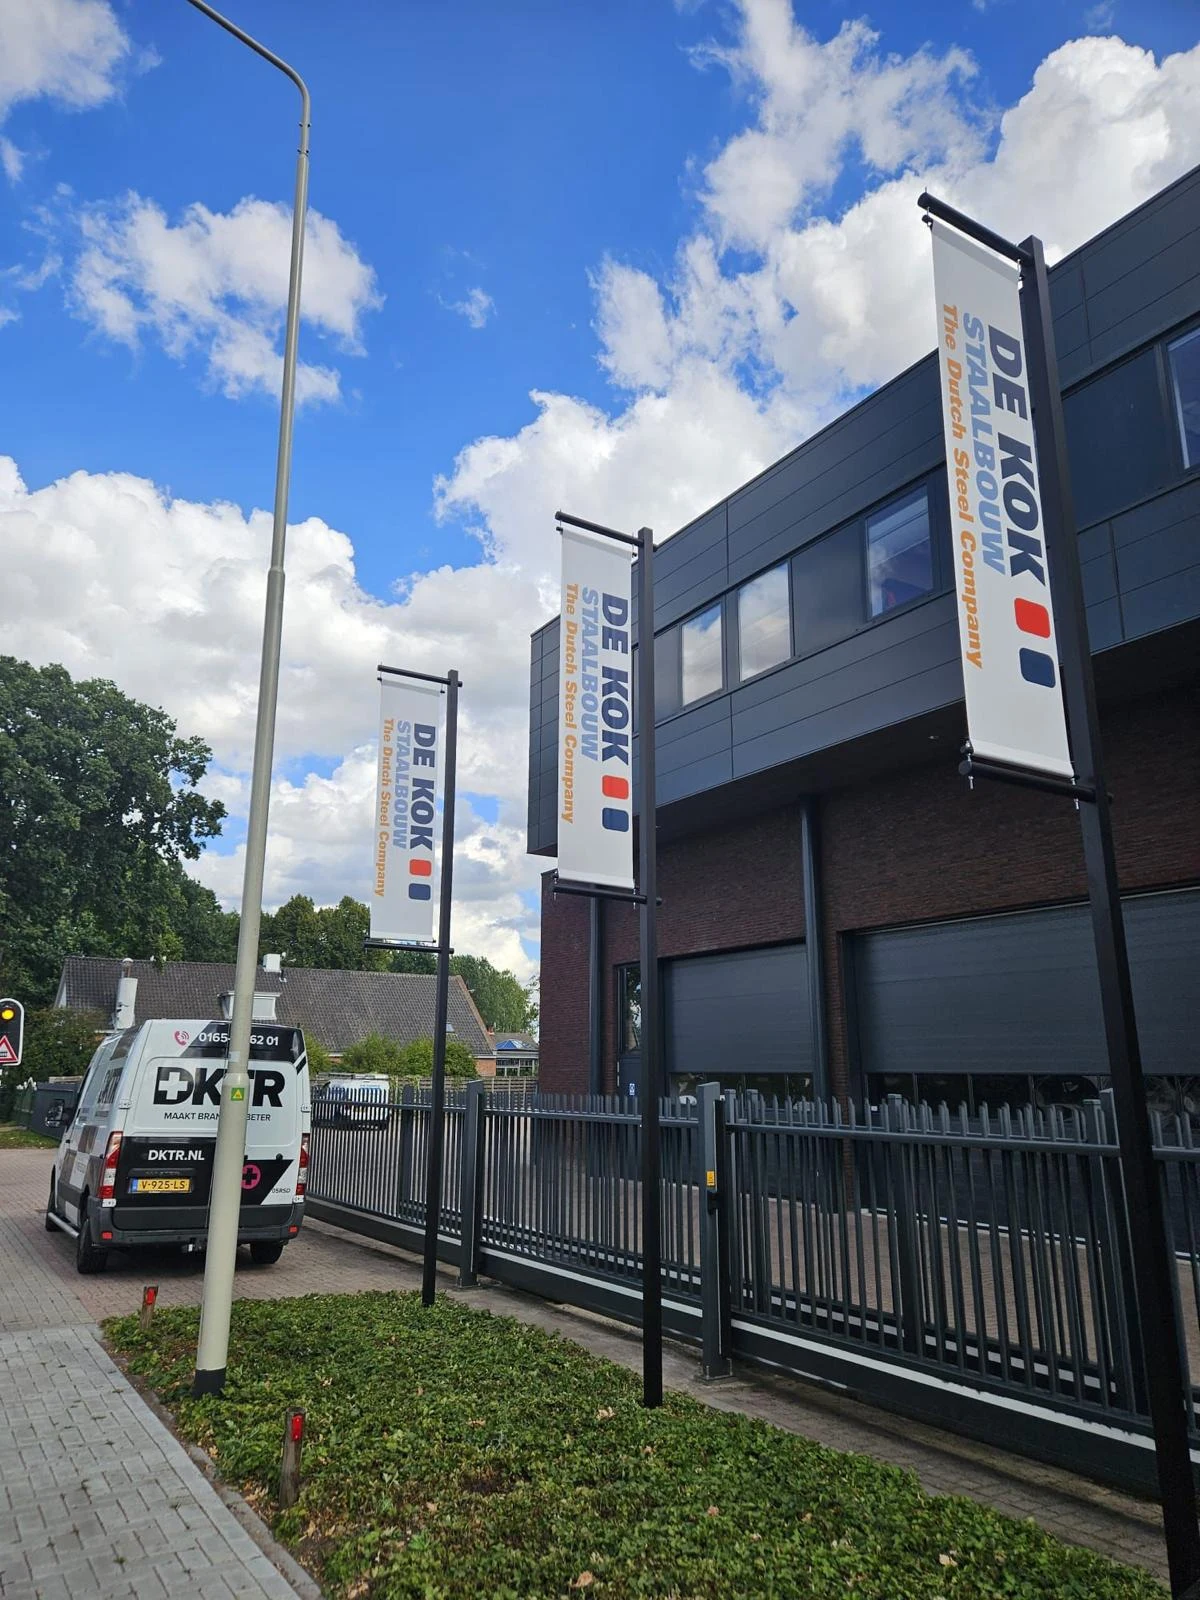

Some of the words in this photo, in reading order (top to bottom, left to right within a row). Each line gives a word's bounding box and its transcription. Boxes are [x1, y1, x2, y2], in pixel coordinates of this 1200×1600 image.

[943, 304, 958, 351] The
[947, 357, 967, 440] Dutch
[988, 325, 1028, 420] DE
[963, 312, 1006, 575] STAALBOUW
[954, 447, 974, 523] Steel
[998, 432, 1046, 587] KOK
[566, 584, 578, 615] The
[601, 593, 629, 655] DE
[960, 530, 983, 669] Company
[566, 622, 578, 674] Dutch
[581, 587, 599, 761] STAALBOUW
[383, 719, 395, 743] The
[565, 681, 577, 729] Steel
[601, 666, 630, 766] KOK
[381, 747, 393, 787] Dutch
[413, 724, 436, 767] DE
[379, 791, 391, 826] Steel
[393, 720, 411, 849] STAALBOUW
[562, 735, 577, 824] Company
[410, 778, 434, 851] KOK
[375, 831, 389, 897] Company
[199, 1032, 231, 1043] 0165-
[250, 1035, 264, 1045] 62
[266, 1036, 279, 1046] 01
[163, 1112, 197, 1121] MAAKT
[141, 1180, 186, 1190] V-925-LS
[147, 1149, 205, 1161] DKTR.NL
